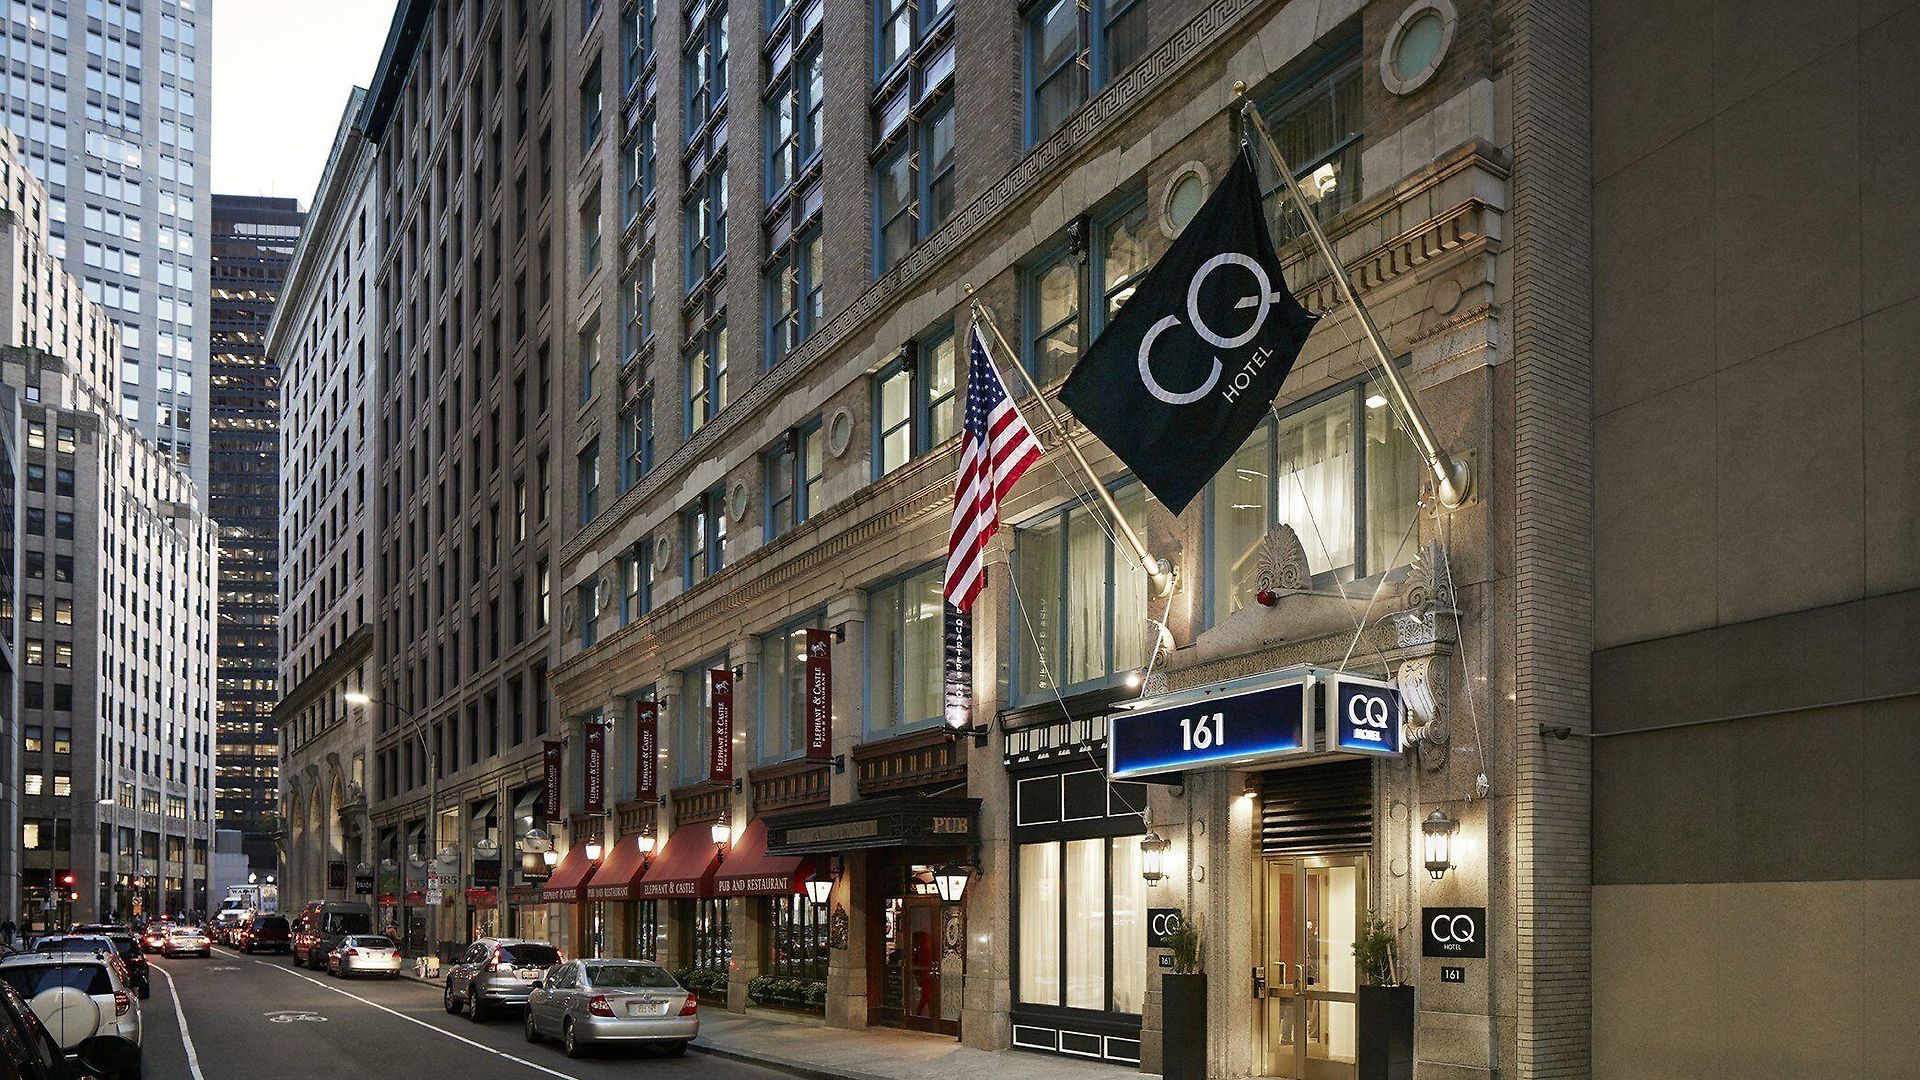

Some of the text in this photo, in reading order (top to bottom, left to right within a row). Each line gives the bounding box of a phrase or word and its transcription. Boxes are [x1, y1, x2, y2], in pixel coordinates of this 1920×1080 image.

[1137, 251, 1281, 405] CQ
[1221, 346, 1274, 404] HOTEL
[955, 618, 964, 679] QUARTERS
[812, 696, 822, 706] &
[1348, 693, 1389, 729] CQ
[715, 726, 724, 735] &
[1179, 712, 1226, 751] 161
[932, 817, 968, 834] PUB
[643, 880, 695, 895] ELEPHANT & CASTLE
[718, 877, 789, 892] PUB AND RESTAURANT
[1430, 914, 1475, 943] CQ
[1443, 943, 1462, 951] HOTEL
[1161, 956, 1172, 965] 161
[1445, 969, 1460, 980] 161
